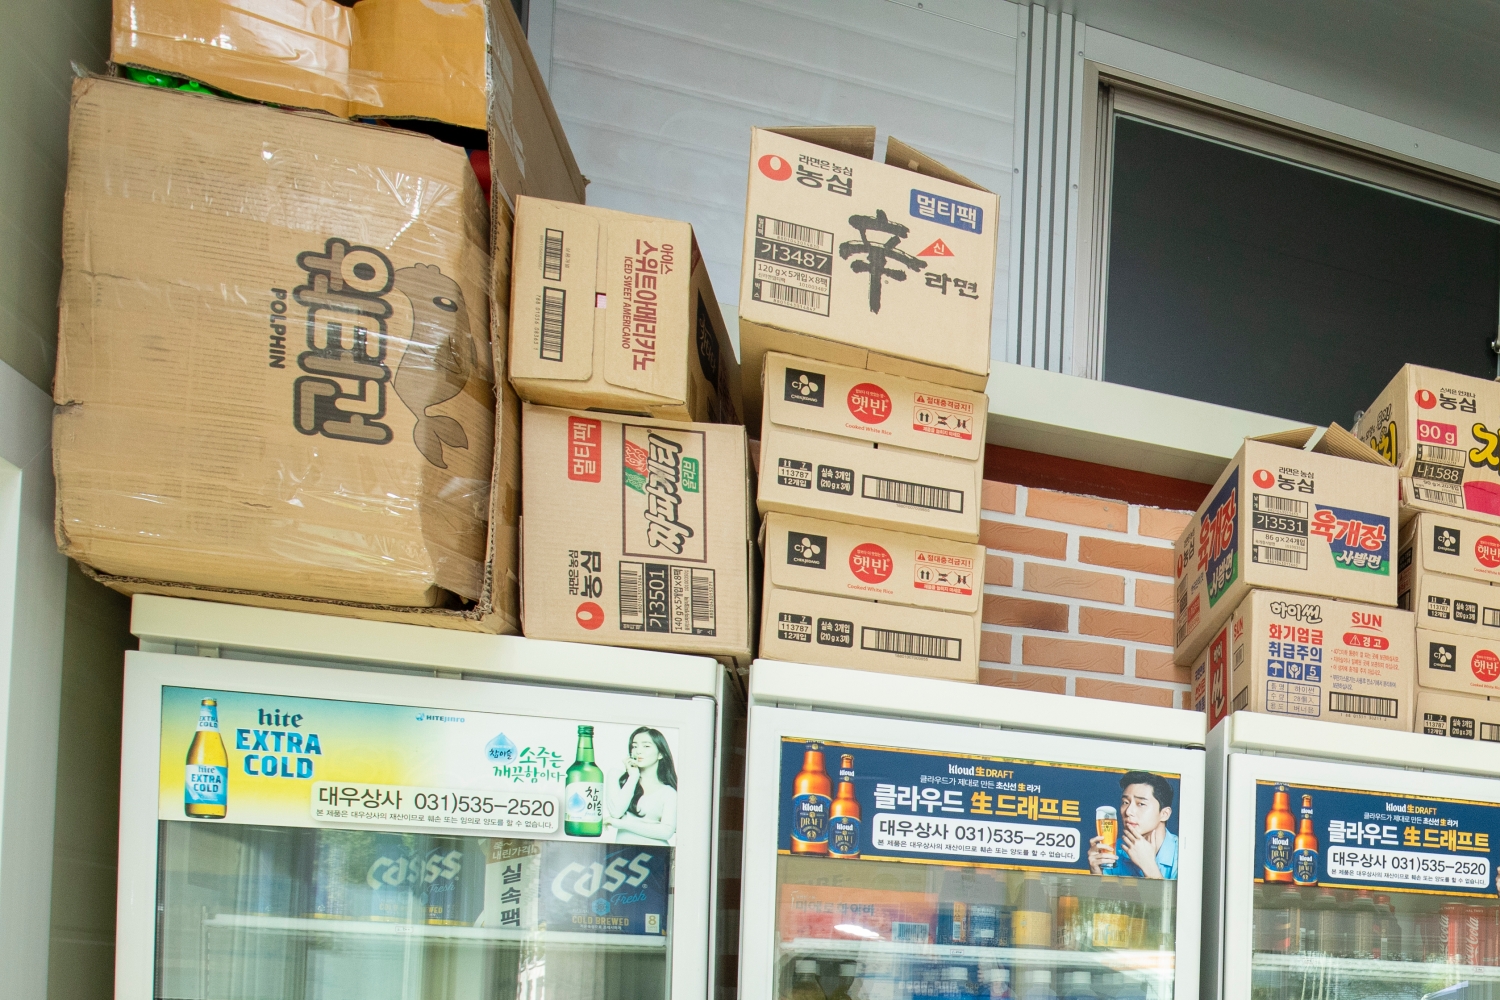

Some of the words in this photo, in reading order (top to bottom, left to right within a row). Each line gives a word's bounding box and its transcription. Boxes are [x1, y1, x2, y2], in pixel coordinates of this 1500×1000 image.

[798, 153, 830, 171] 라면은
[831, 161, 853, 177] 농심
[795, 164, 853, 197] 농심
[916, 194, 978, 229] 멀티팩
[660, 243, 674, 275] 아이스
[760, 240, 829, 270] 가3487
[932, 242, 945, 256] 신
[624, 256, 633, 275] ICED
[838, 209, 928, 315] 辛
[623, 276, 633, 301] SWEET
[924, 271, 980, 300] 라면
[632, 239, 658, 370] 스위트아메리카노
[268, 286, 288, 370] POLPHIN
[622, 302, 632, 350] AMERICANO
[293, 237, 395, 444] 워터건
[851, 394, 888, 416] 햇반
[926, 395, 972, 413] 절대충격금지!
[1439, 393, 1477, 414] 농심
[845, 422, 864, 431] Cooked
[865, 425, 882, 434] White
[882, 428, 892, 436] Rice
[1419, 424, 1441, 440] 90
[1444, 431, 1456, 445] g
[573, 422, 597, 476] 멀티팩
[683, 460, 697, 490] 올리브
[780, 468, 810, 479] 113787
[785, 477, 807, 487] 12개입
[820, 467, 833, 479] 실속
[834, 470, 852, 482] 3개입
[1417, 467, 1459, 482] 나1588
[643, 432, 694, 555] 짜파게티
[1277, 474, 1315, 495] 농심
[1256, 515, 1304, 533] 가3531
[1310, 509, 1387, 549] 육개장
[568, 549, 579, 568] 농심
[853, 554, 889, 576] 햇반
[1336, 551, 1382, 568] 사발면
[580, 550, 603, 599] 농심
[648, 568, 667, 628] 가3501
[1351, 611, 1382, 627] SUN
[1268, 623, 1324, 643] 화기엄금
[1362, 636, 1382, 648] 경고
[1268, 641, 1323, 663] 취급주의
[257, 708, 304, 728] hite
[236, 728, 322, 755] EXTRA
[489, 748, 513, 760] 참이슬
[519, 747, 565, 768] 소주는
[243, 755, 315, 779] COLD
[948, 764, 975, 776] Kloud
[975, 767, 985, 777] 生
[986, 769, 1014, 779] DRAFT
[191, 773, 222, 784] EXTRA
[193, 783, 219, 793] COLD
[920, 774, 956, 786] 클라우드가
[958, 778, 979, 787] 제대로
[980, 780, 994, 789] 만든
[996, 782, 1016, 791] 초신선
[1017, 783, 1026, 792] 生
[1027, 784, 1041, 793] 라거
[319, 787, 402, 810] 대우상사
[874, 783, 964, 813] 클라우드
[970, 791, 993, 815] 生
[995, 794, 1081, 822] 드래프트
[1386, 802, 1407, 813] Kloud
[1407, 804, 1415, 814] 生
[1415, 806, 1437, 815] DRAFT
[316, 809, 324, 817] 본
[326, 810, 349, 818] 제품은
[350, 811, 387, 820] 대우상사의
[389, 813, 425, 822] 재산이므로
[427, 814, 441, 822] 훼손
[444, 815, 458, 823] 또는
[460, 816, 481, 825] 임의로
[483, 818, 504, 826] 양도를
[506, 819, 513, 827] 할
[525, 821, 554, 829] 없습니다.
[879, 820, 949, 840] 대우상사
[1328, 820, 1399, 846] 클라우드
[1403, 826, 1421, 847] 生
[1423, 828, 1490, 852] 드래프트
[1332, 852, 1387, 869] 대우상사
[500, 862, 522, 928] 실속팩
[572, 915, 593, 926] COLD
[595, 916, 630, 927] BREWED
